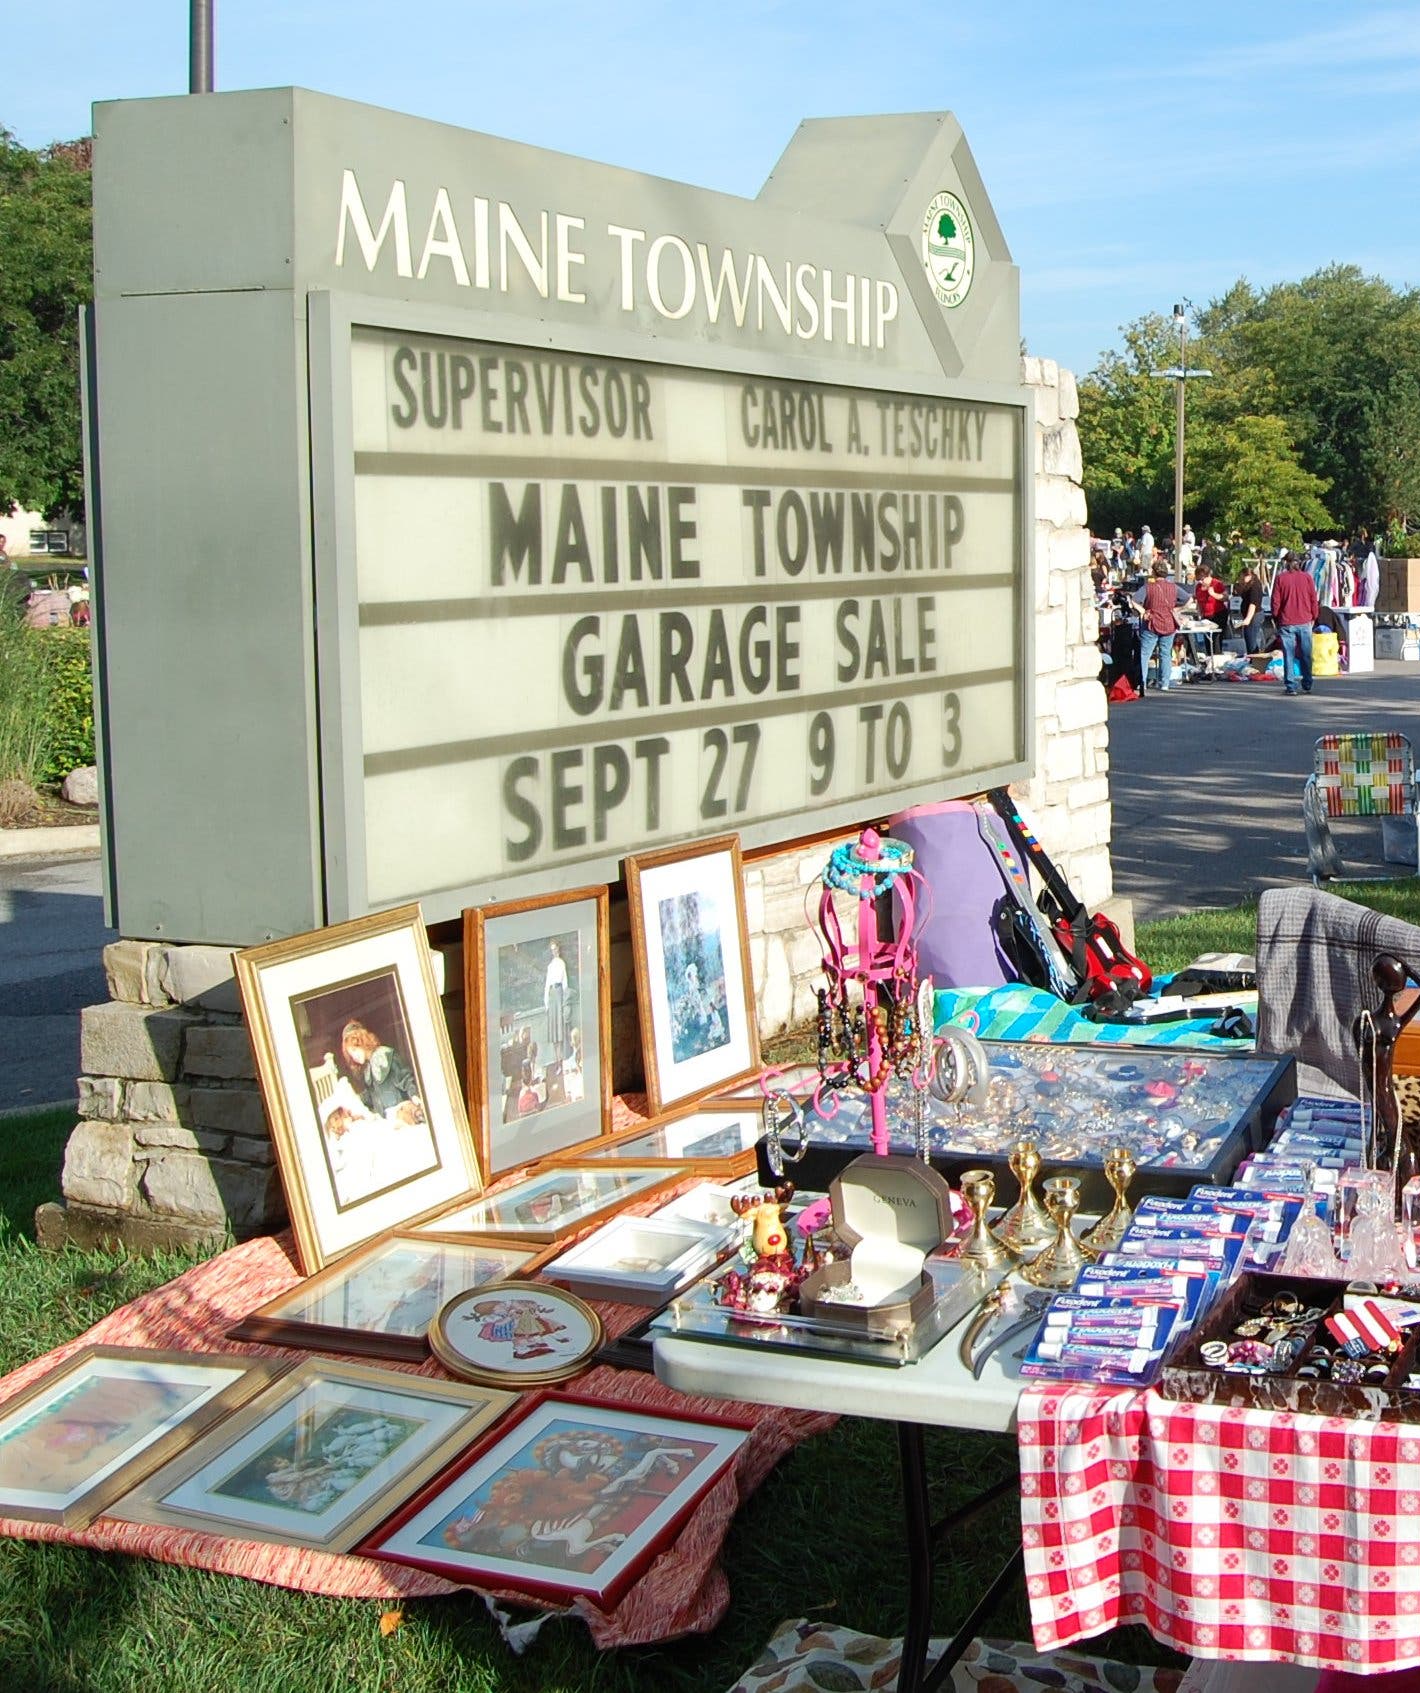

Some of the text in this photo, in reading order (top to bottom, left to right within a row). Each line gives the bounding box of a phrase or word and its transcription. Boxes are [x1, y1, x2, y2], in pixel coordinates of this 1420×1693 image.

[336, 168, 899, 349] MAINE TOWNSHIP
[391, 346, 988, 463] SUPERVISOR CAROL A. TESCHKY
[488, 481, 965, 587] MAINE TOWNSHIP
[562, 595, 937, 716] GARAGE SALE
[502, 691, 963, 863] SEPT 27 9 TO 3
[874, 1196, 917, 1208] GENEVA
